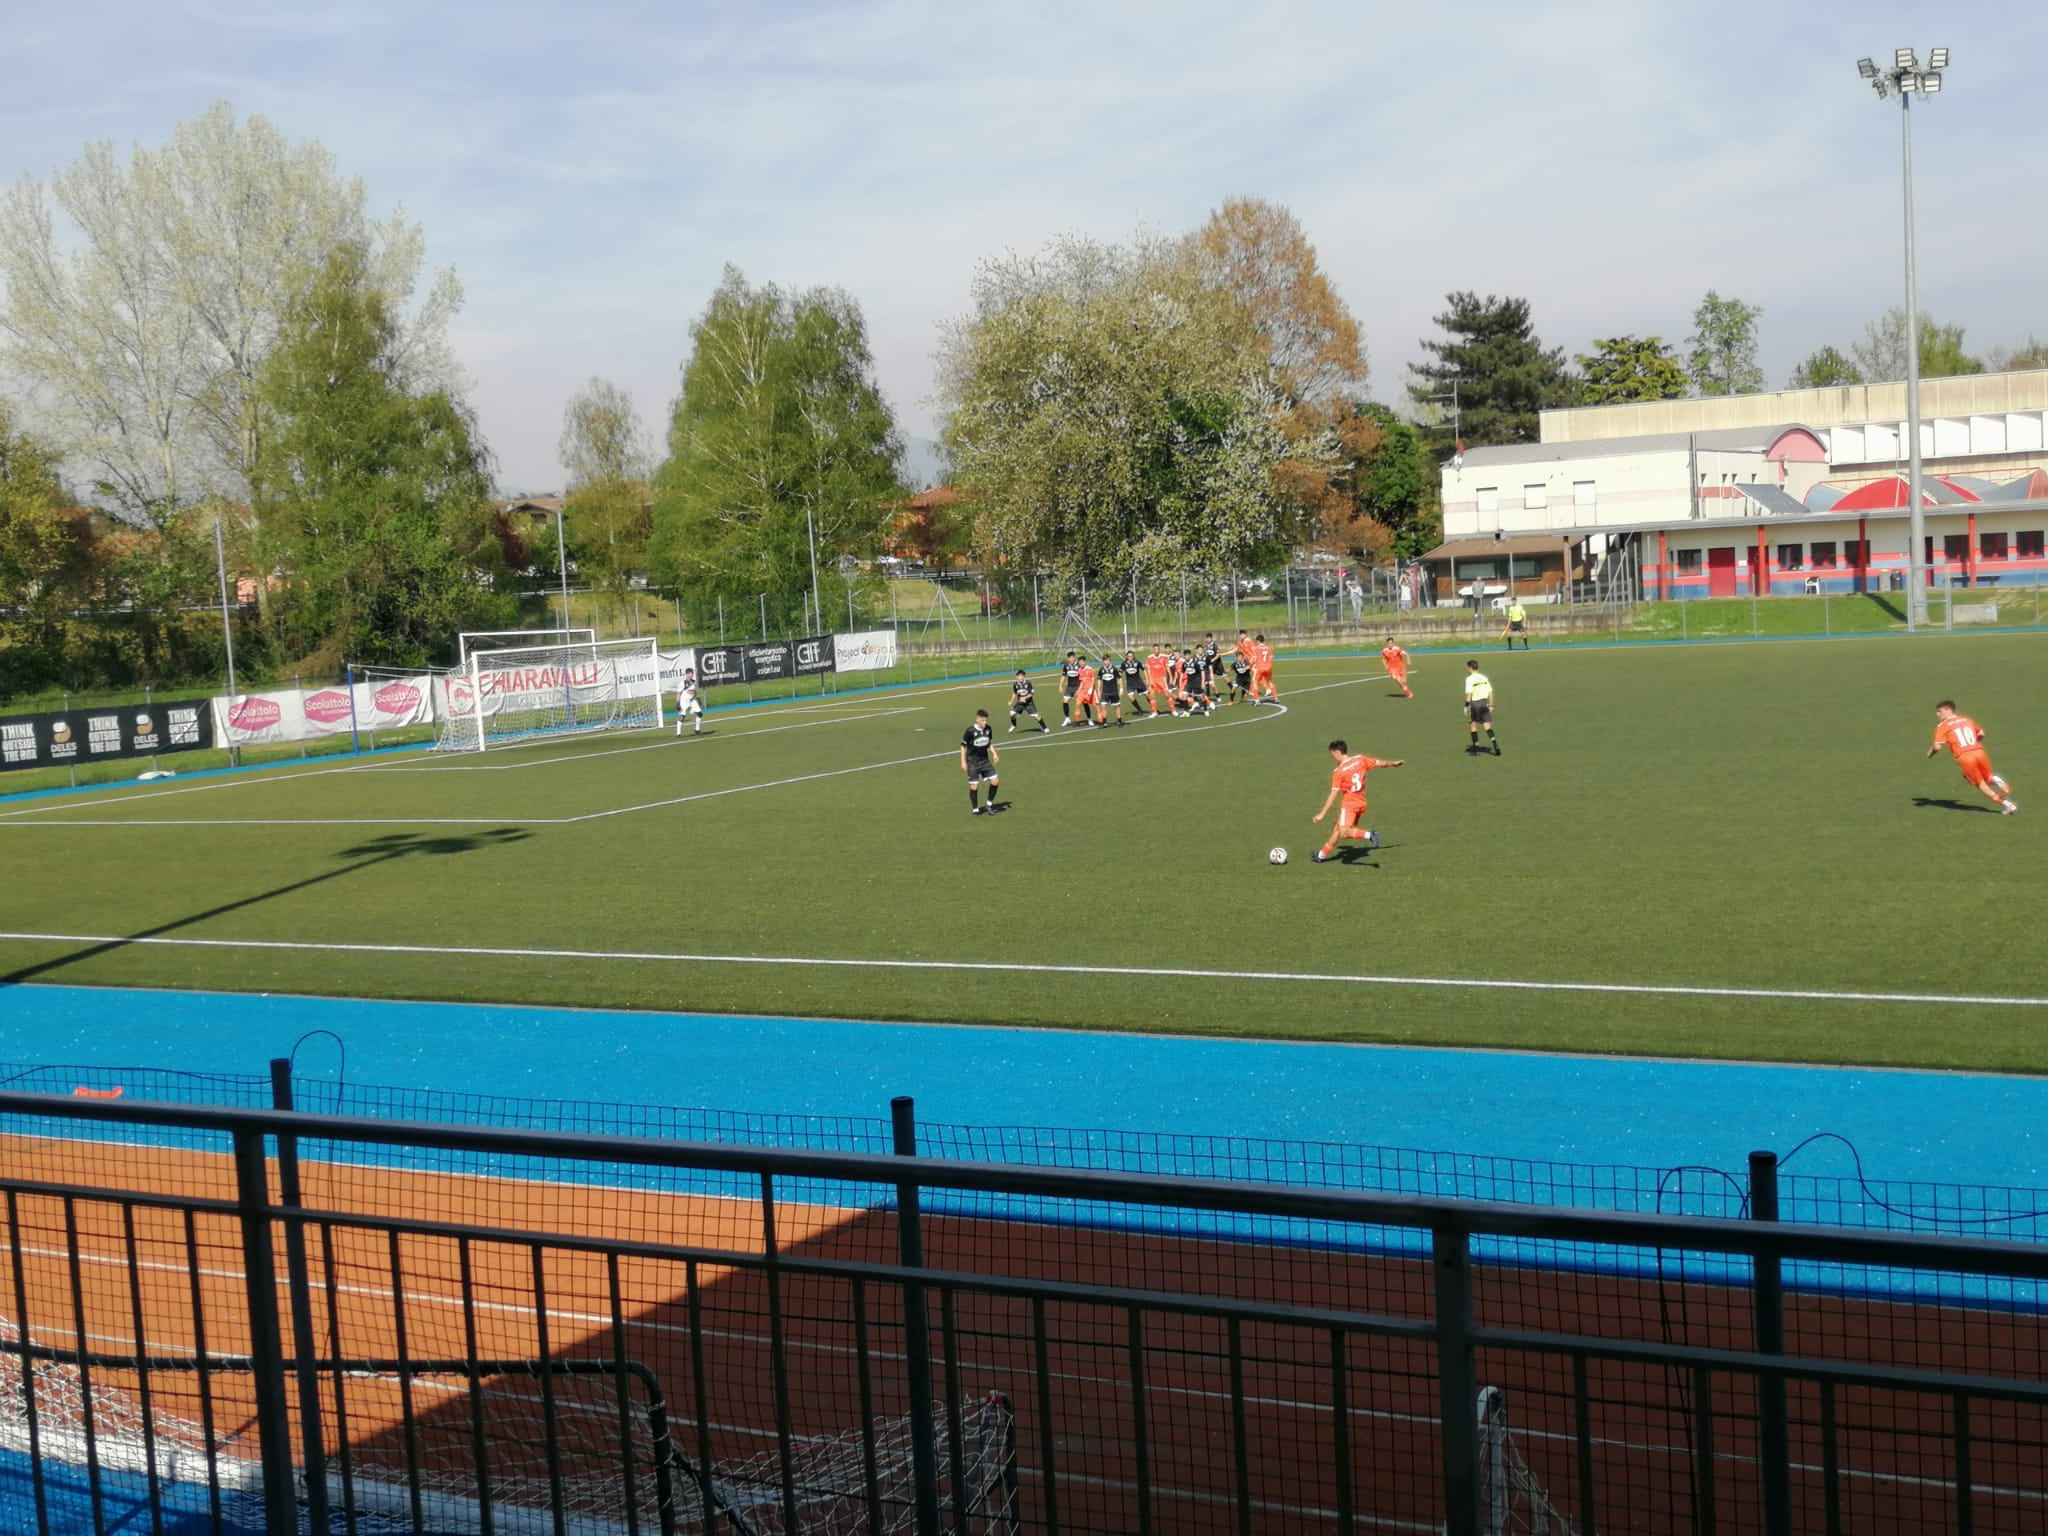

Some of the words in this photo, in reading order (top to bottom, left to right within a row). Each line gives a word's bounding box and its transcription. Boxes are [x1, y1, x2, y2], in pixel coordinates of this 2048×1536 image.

[837, 648, 860, 659] Project
[1262, 651, 1269, 662] 7
[477, 663, 598, 695] CHIARAVALLI
[375, 689, 419, 703] Scoiattolo
[305, 697, 351, 711] Scoiattolo
[230, 705, 279, 719] Scoiattolo
[88, 715, 119, 731] THINK
[0, 723, 35, 740] THINK
[89, 730, 121, 742] OUTSIDE
[1954, 726, 1976, 747] 10
[2, 738, 37, 751] OUTSIDE
[90, 741, 105, 753] THE
[105, 739, 121, 752] BOX
[133, 734, 158, 745] DELES
[50, 742, 77, 753] DELES
[3, 750, 20, 762] THE
[20, 748, 38, 760] BOX
